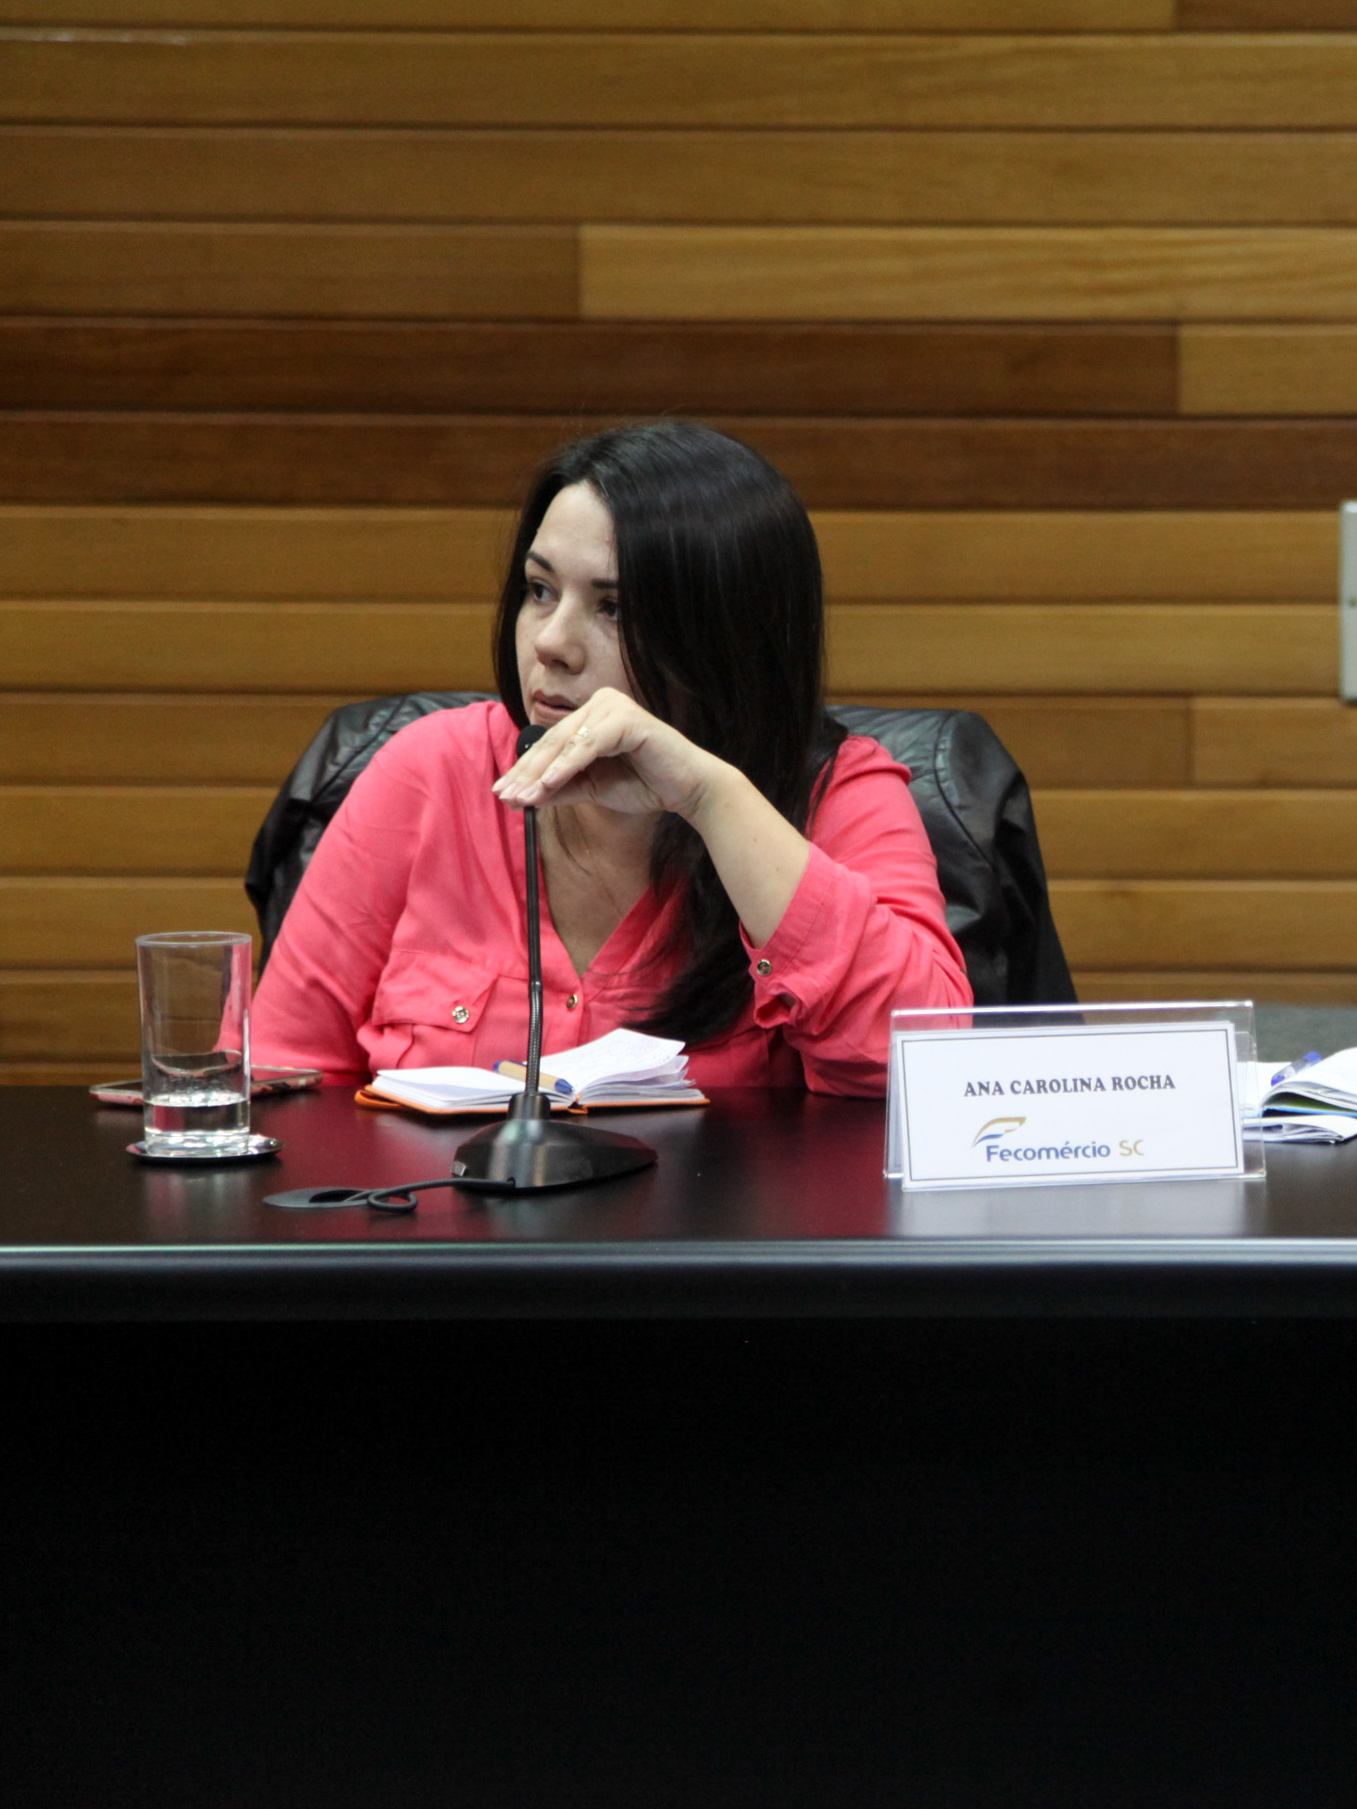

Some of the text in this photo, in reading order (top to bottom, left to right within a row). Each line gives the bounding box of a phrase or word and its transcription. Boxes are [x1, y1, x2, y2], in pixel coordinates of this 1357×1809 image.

[963, 1074, 1176, 1097] ANA CAROLINA ROCHA
[985, 1139, 1145, 1163] Fecomércio SC
